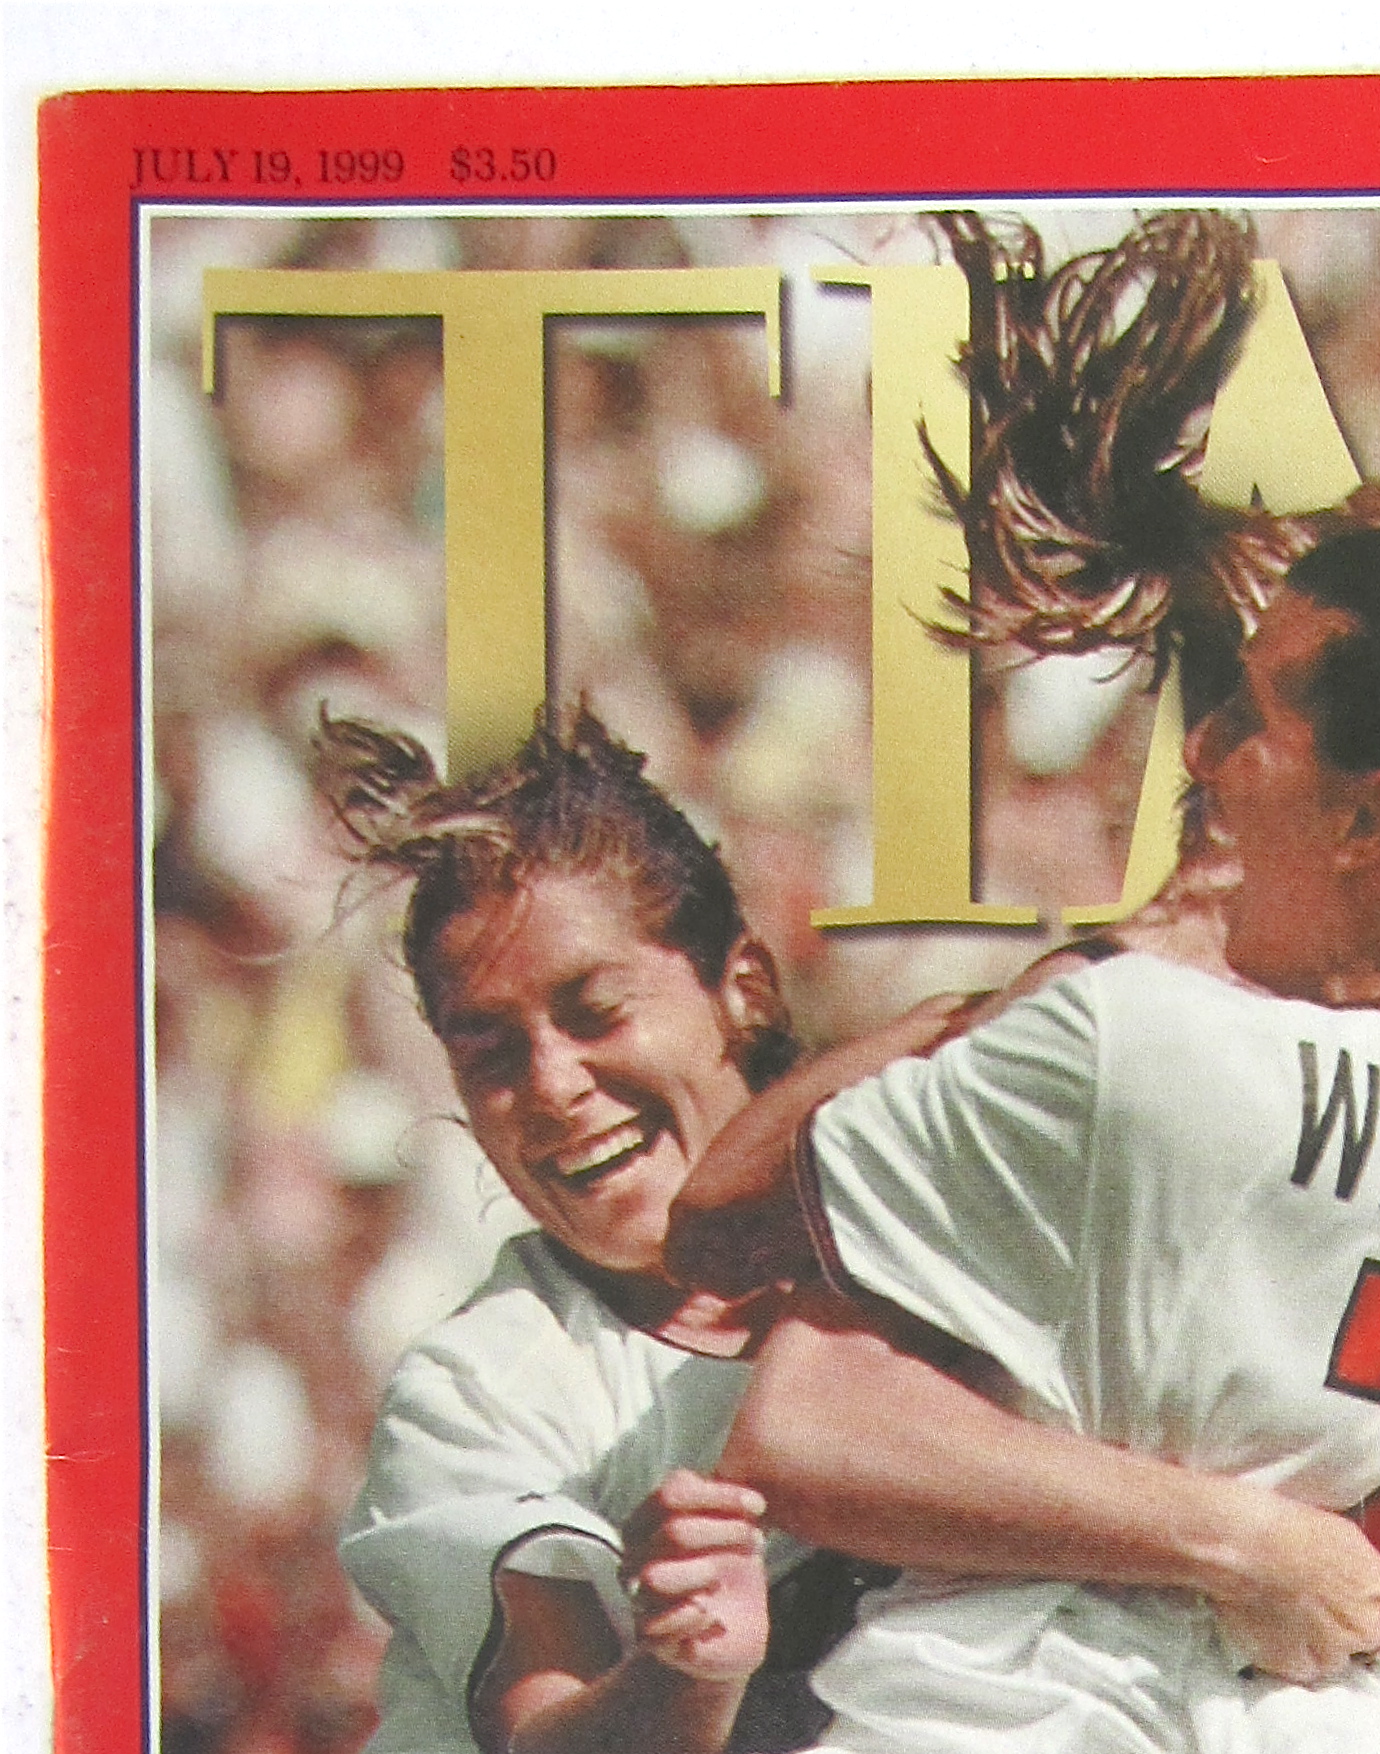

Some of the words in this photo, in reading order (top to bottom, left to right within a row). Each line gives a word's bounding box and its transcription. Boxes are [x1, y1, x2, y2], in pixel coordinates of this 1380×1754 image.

[131, 147, 240, 190] JULY
[254, 150, 301, 188] 19,
[318, 148, 405, 183] 1999
[450, 145, 557, 186] $3.50
